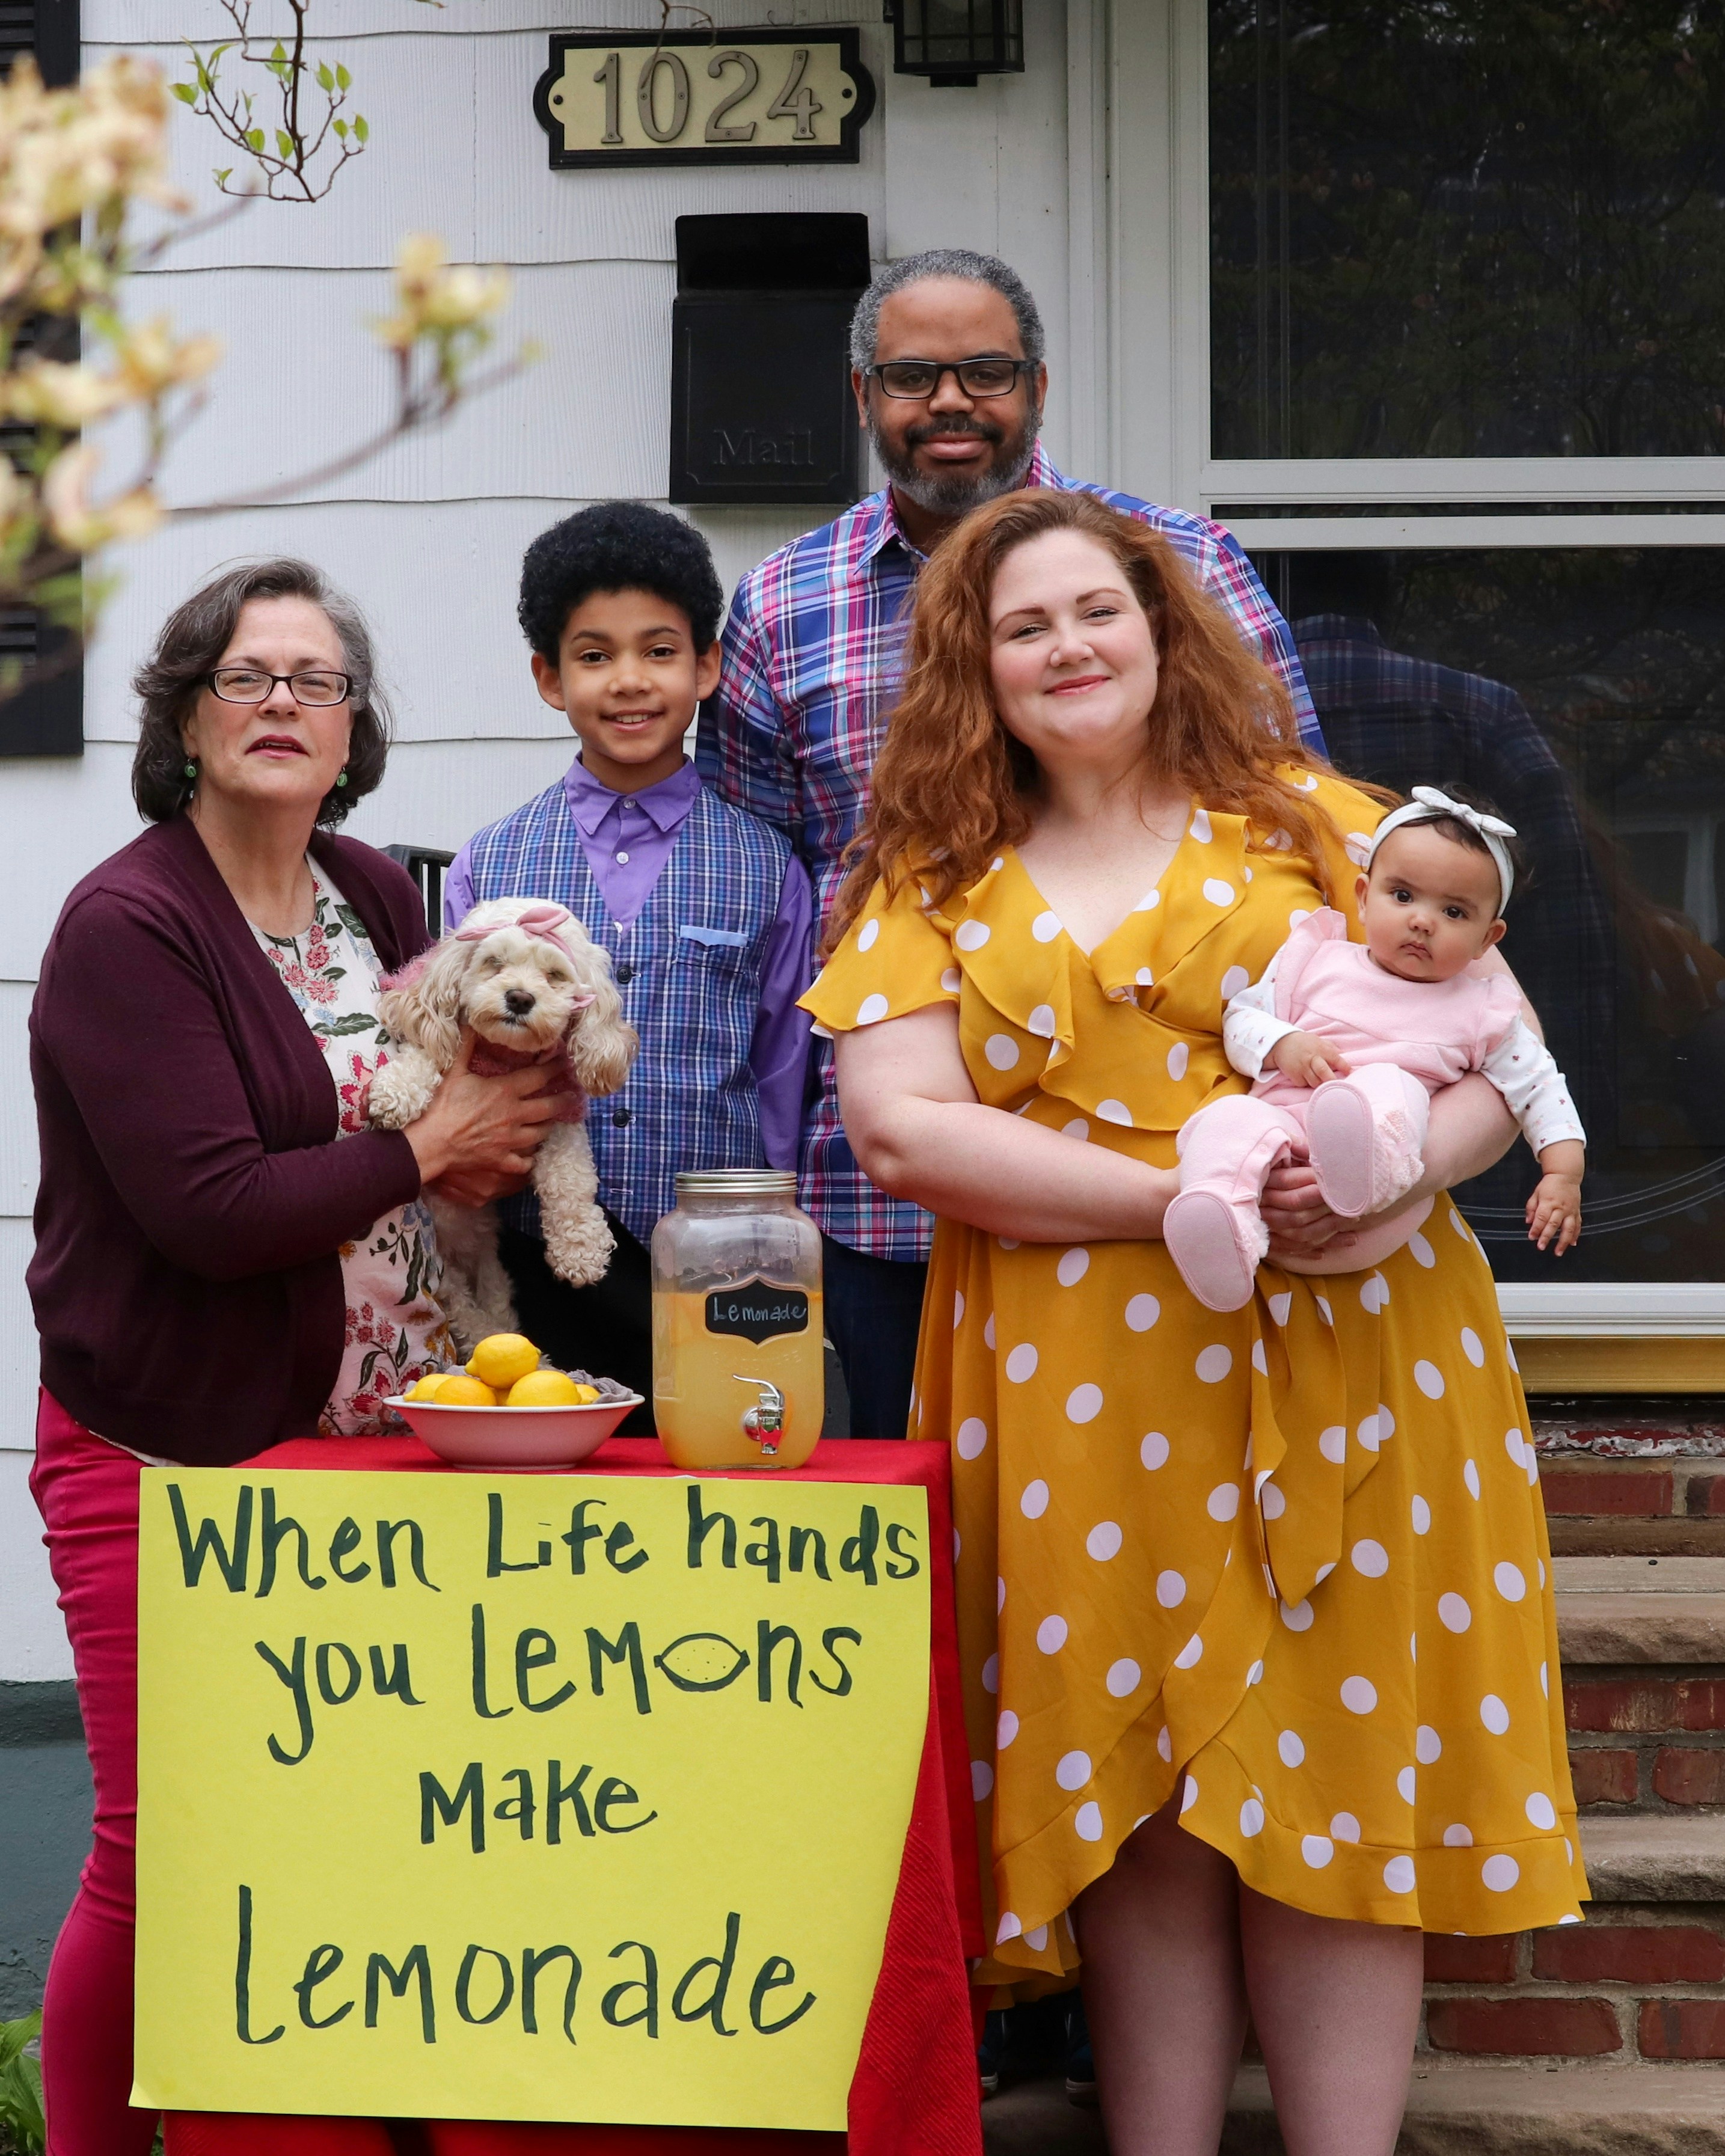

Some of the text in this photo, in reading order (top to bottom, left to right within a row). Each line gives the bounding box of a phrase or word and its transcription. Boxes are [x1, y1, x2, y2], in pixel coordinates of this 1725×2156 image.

[593, 49, 823, 144] 1024
[712, 429, 814, 465] Mail
[713, 1296, 807, 1322] Lemonade
[166, 1483, 921, 1598] When Life hands
[254, 1636, 426, 1766] you
